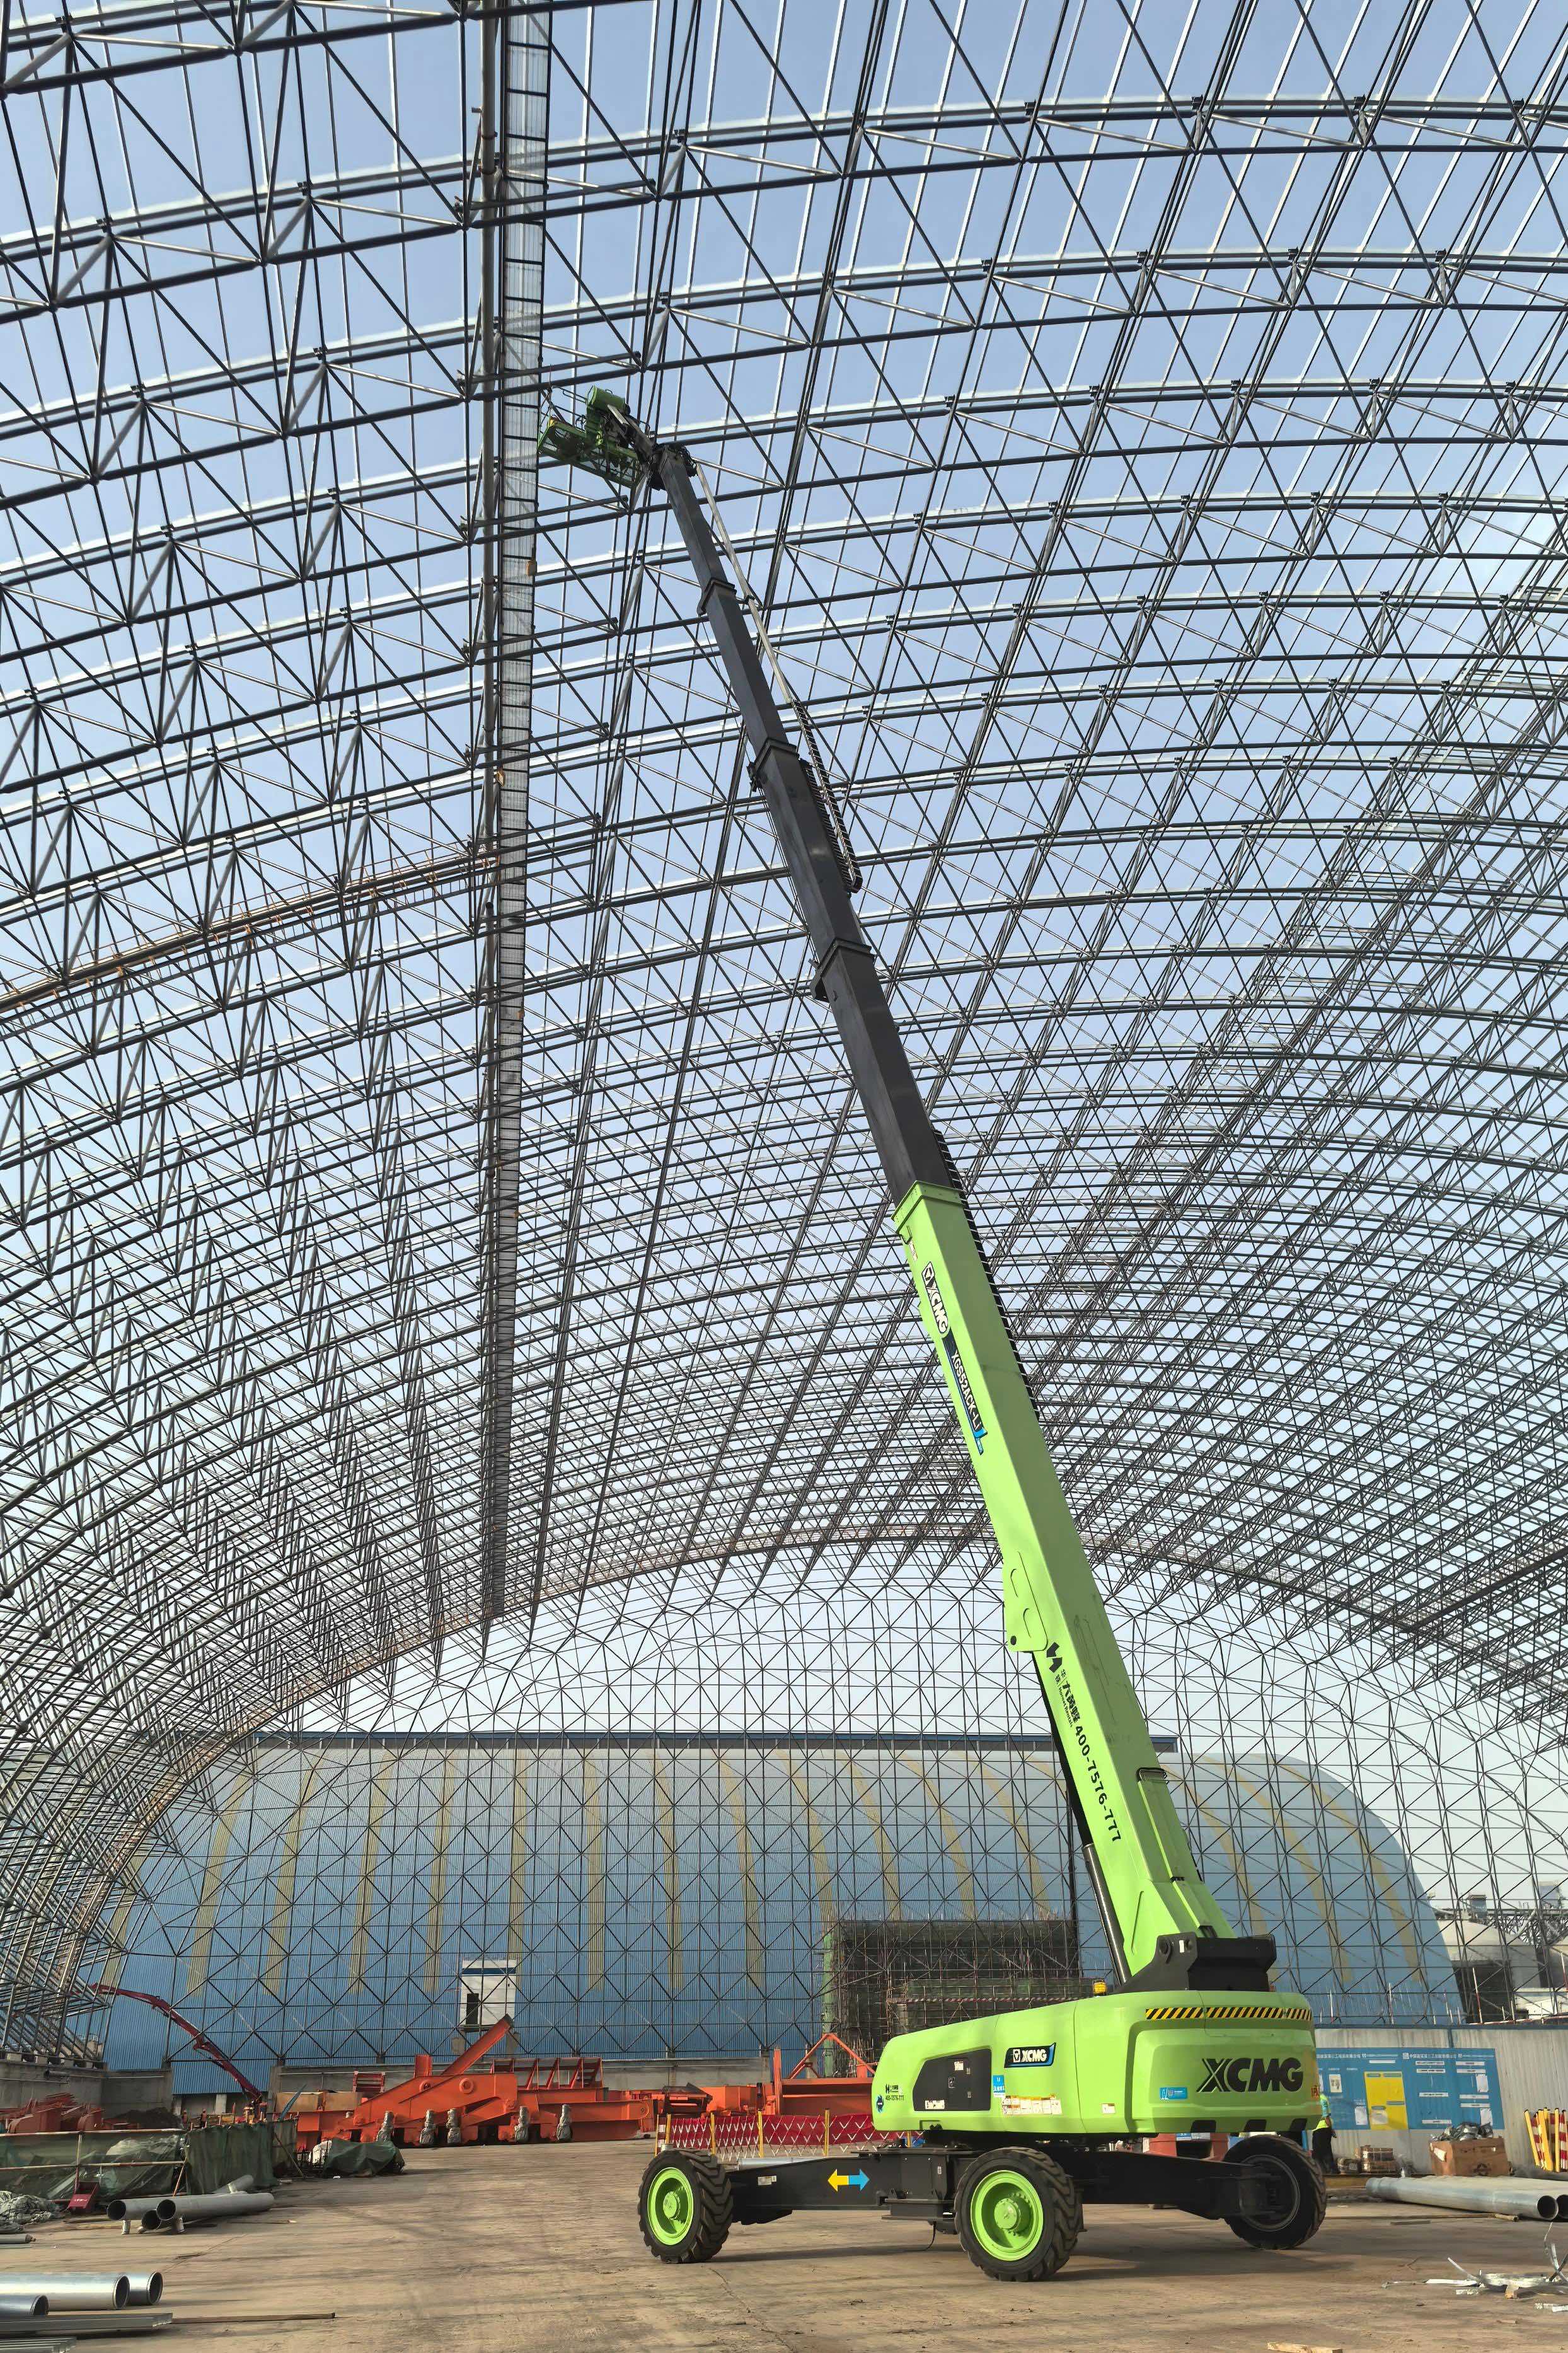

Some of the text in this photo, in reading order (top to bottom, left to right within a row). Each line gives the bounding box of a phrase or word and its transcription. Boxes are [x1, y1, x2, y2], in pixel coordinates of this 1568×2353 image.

[925, 1280, 948, 1333] XCMG
[1075, 1726, 1121, 1841] 400-7576-777
[1022, 2049, 1047, 2062] XCMG
[1196, 2057, 1304, 2093] XCMG
